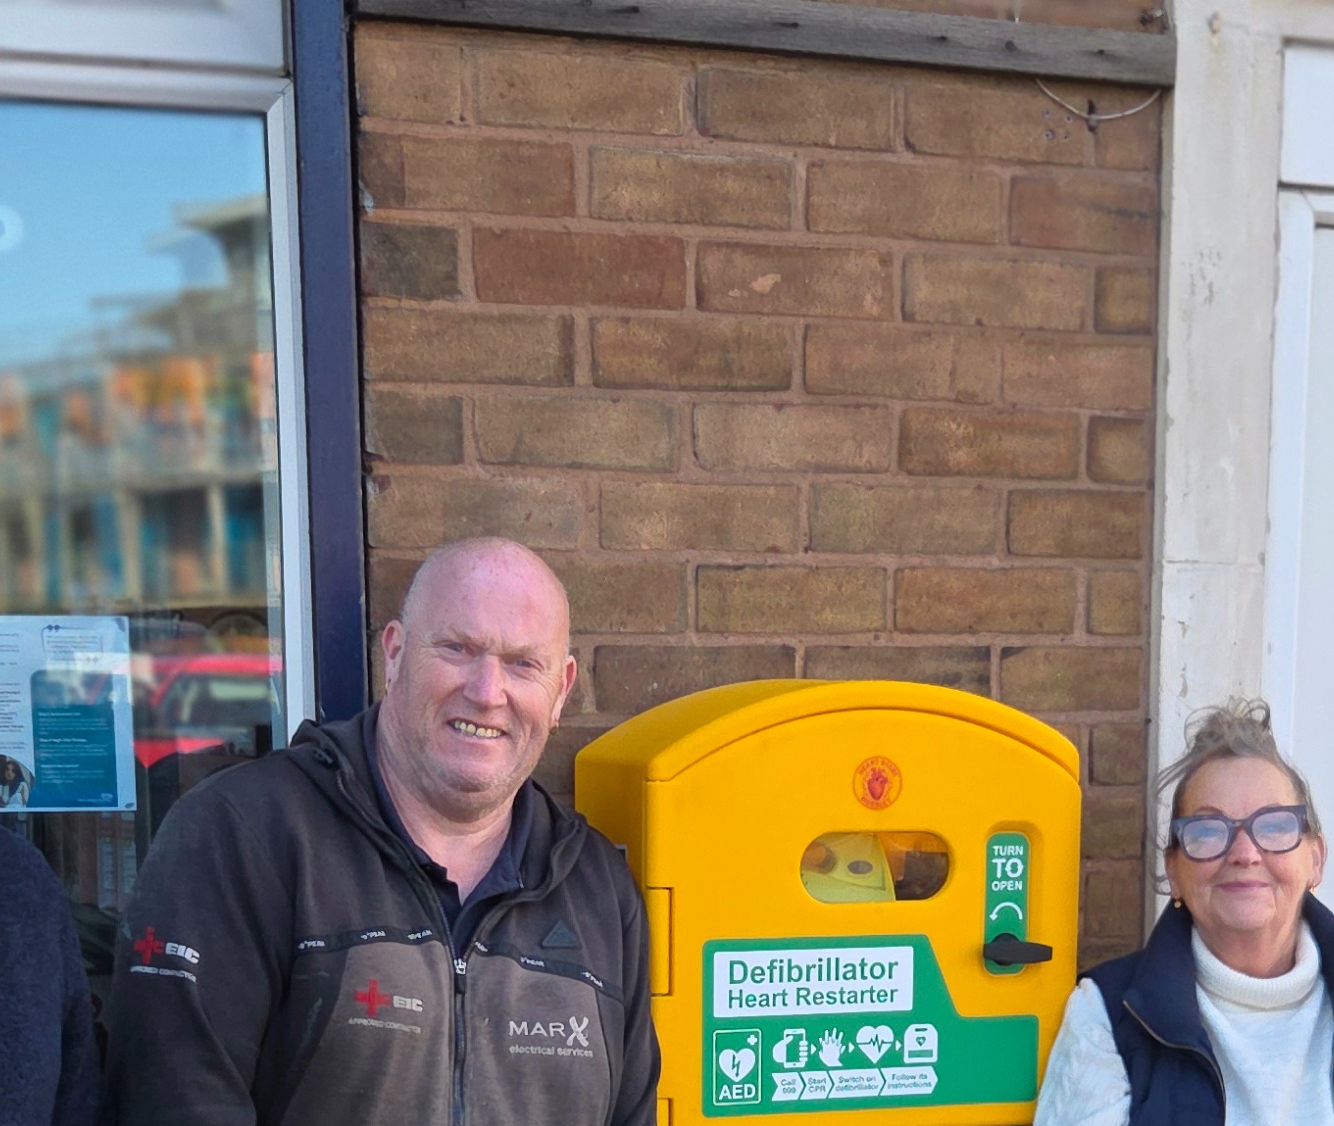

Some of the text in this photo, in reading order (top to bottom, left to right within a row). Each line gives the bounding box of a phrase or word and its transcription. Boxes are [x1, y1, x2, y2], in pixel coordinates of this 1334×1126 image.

[992, 845, 1024, 856] TURN
[992, 858, 1024, 878] TO
[991, 880, 1023, 891] OPEN
[165, 942, 200, 964] EIC
[729, 957, 899, 985] Defibrillator
[728, 985, 899, 1009] Heart Restarter
[393, 995, 423, 1013] EIC
[508, 1016, 589, 1048] MARX
[509, 1044, 594, 1058] electrical services
[780, 1078, 796, 1087] Call
[808, 1077, 827, 1085] Start
[838, 1075, 864, 1083] Switch
[891, 1073, 916, 1081] Follow
[808, 1085, 826, 1093] CPR
[835, 1083, 879, 1092] defibrillator
[887, 1080, 932, 1089] instructions
[718, 1083, 757, 1101] AED
